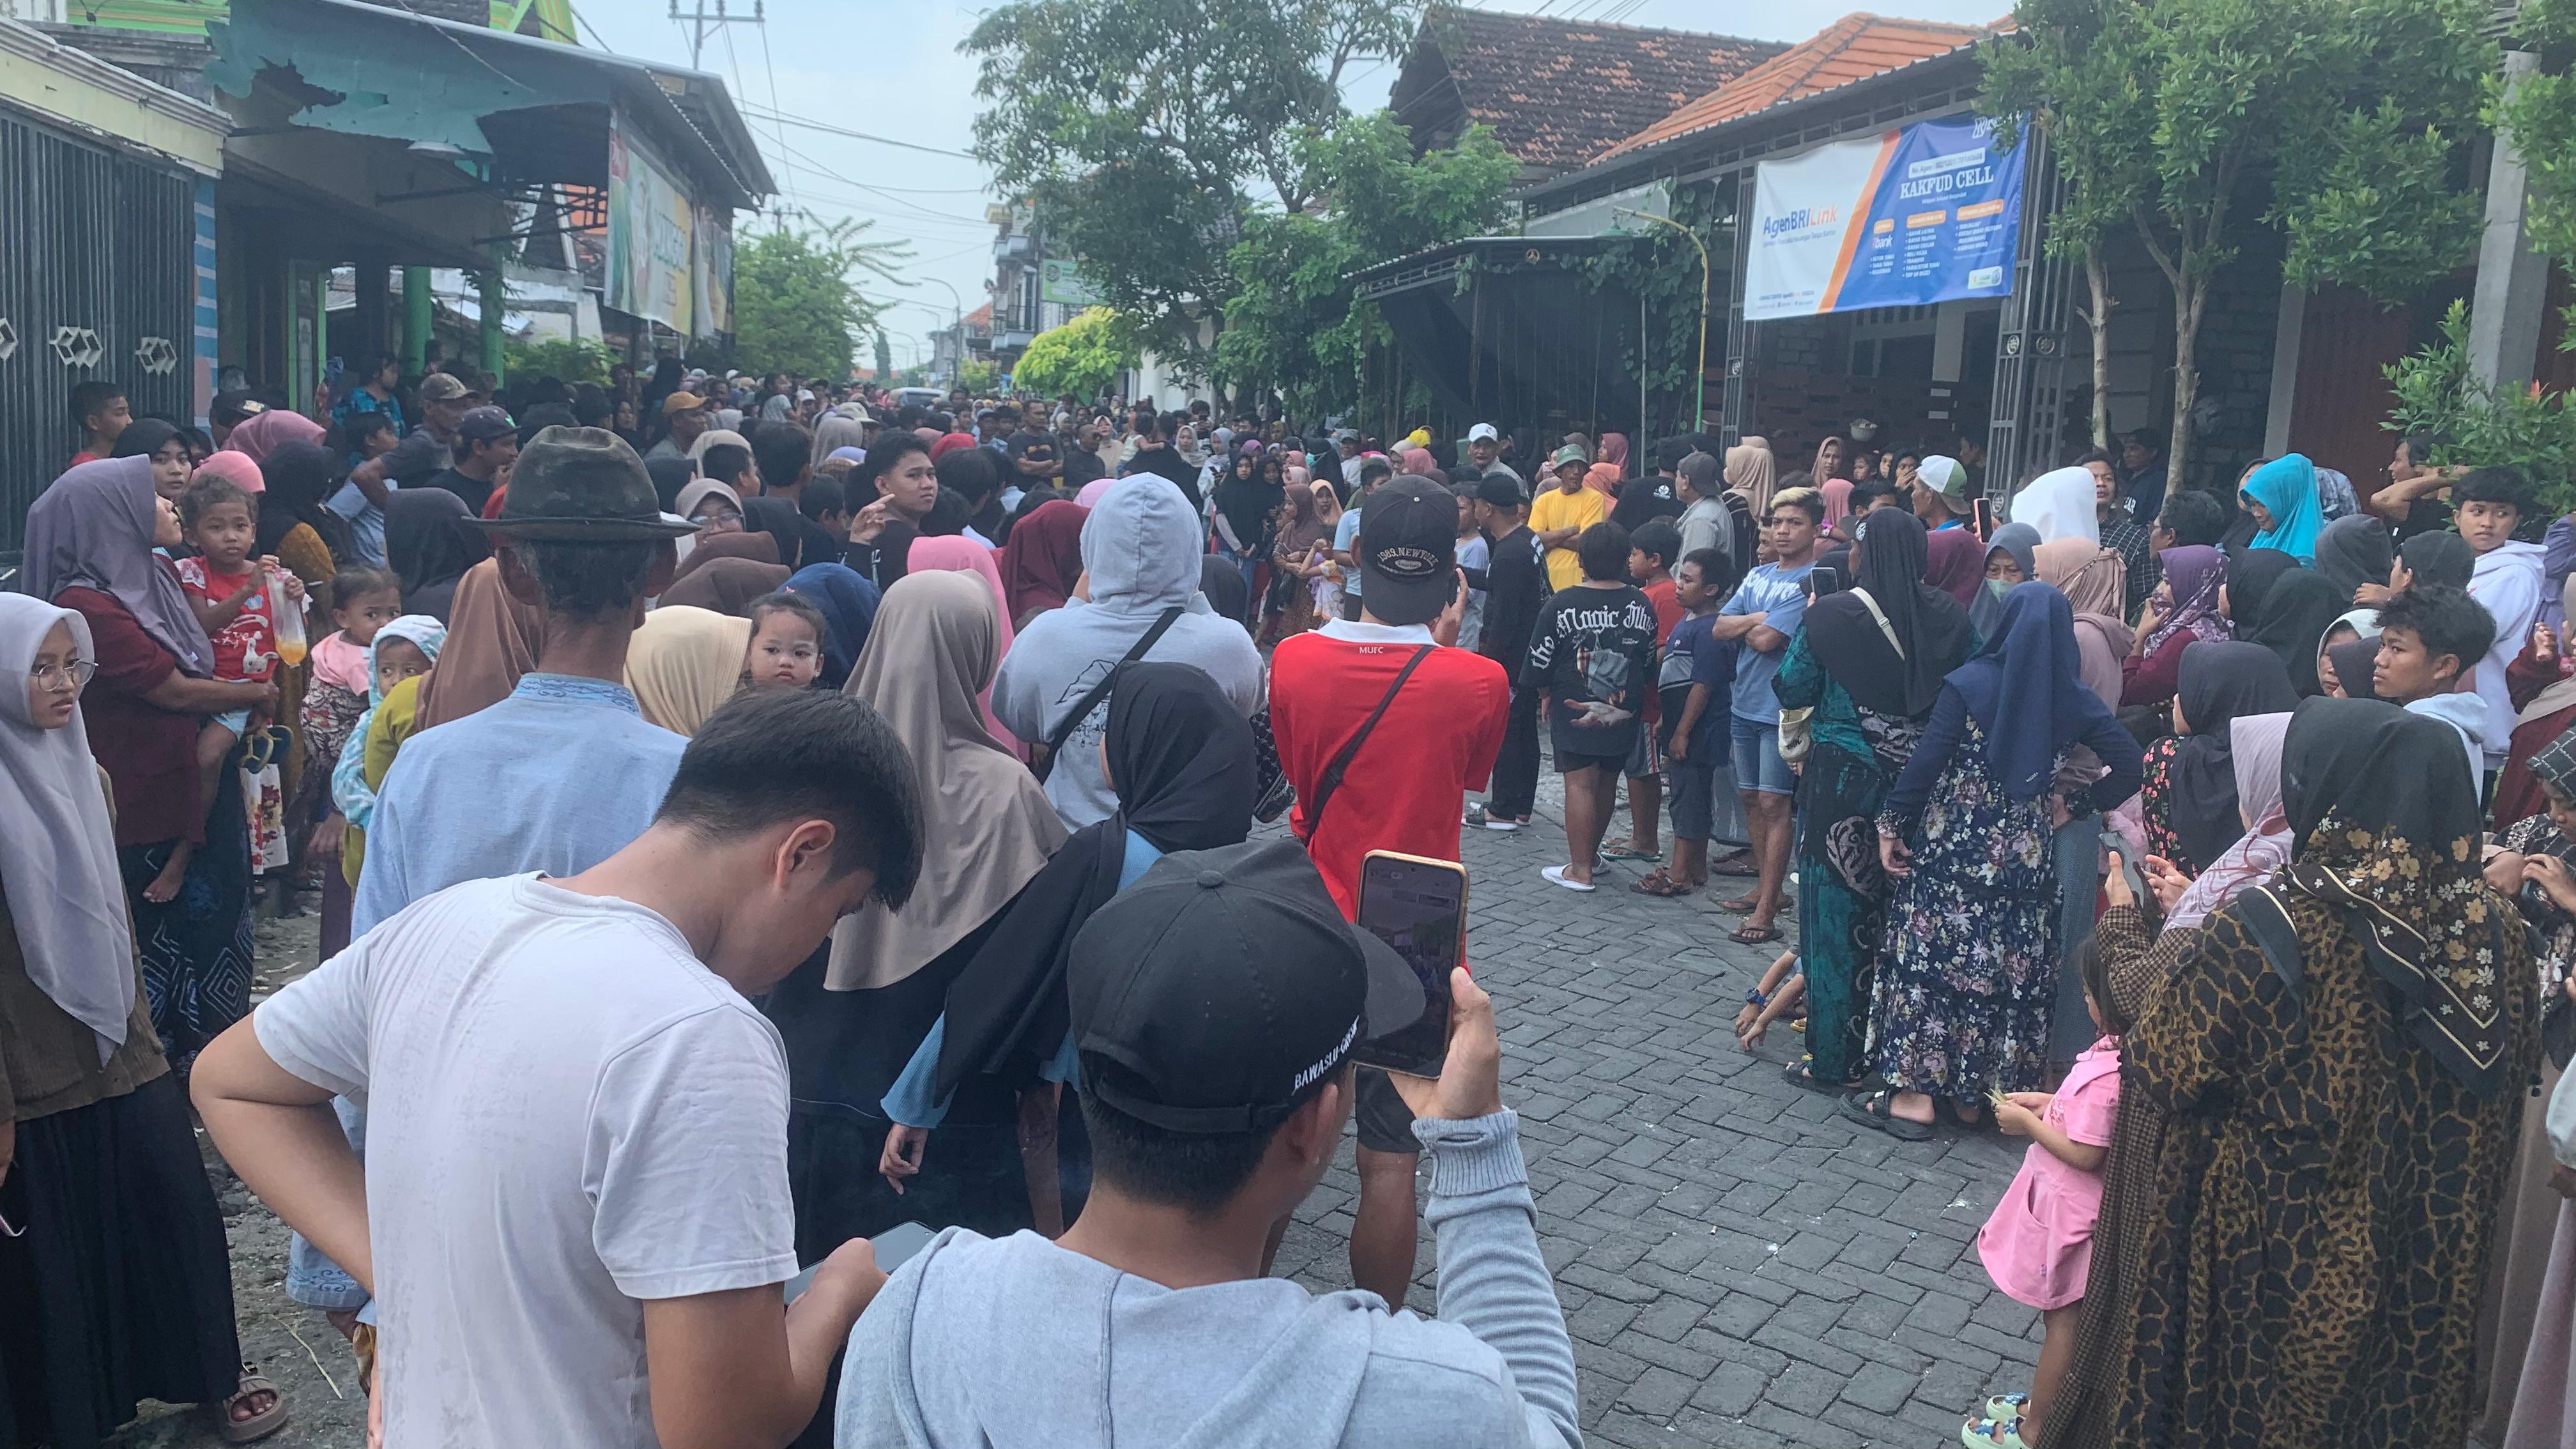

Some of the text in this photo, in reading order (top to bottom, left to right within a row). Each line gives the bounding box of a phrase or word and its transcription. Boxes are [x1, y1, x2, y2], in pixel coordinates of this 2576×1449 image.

[1899, 174, 1953, 199] KAKFUD
[1956, 165, 1994, 189] CELL
[1763, 205, 1837, 239] AgenBRILink
[1557, 605, 1620, 638] Magic
[1359, 646, 1384, 654] MUFC
